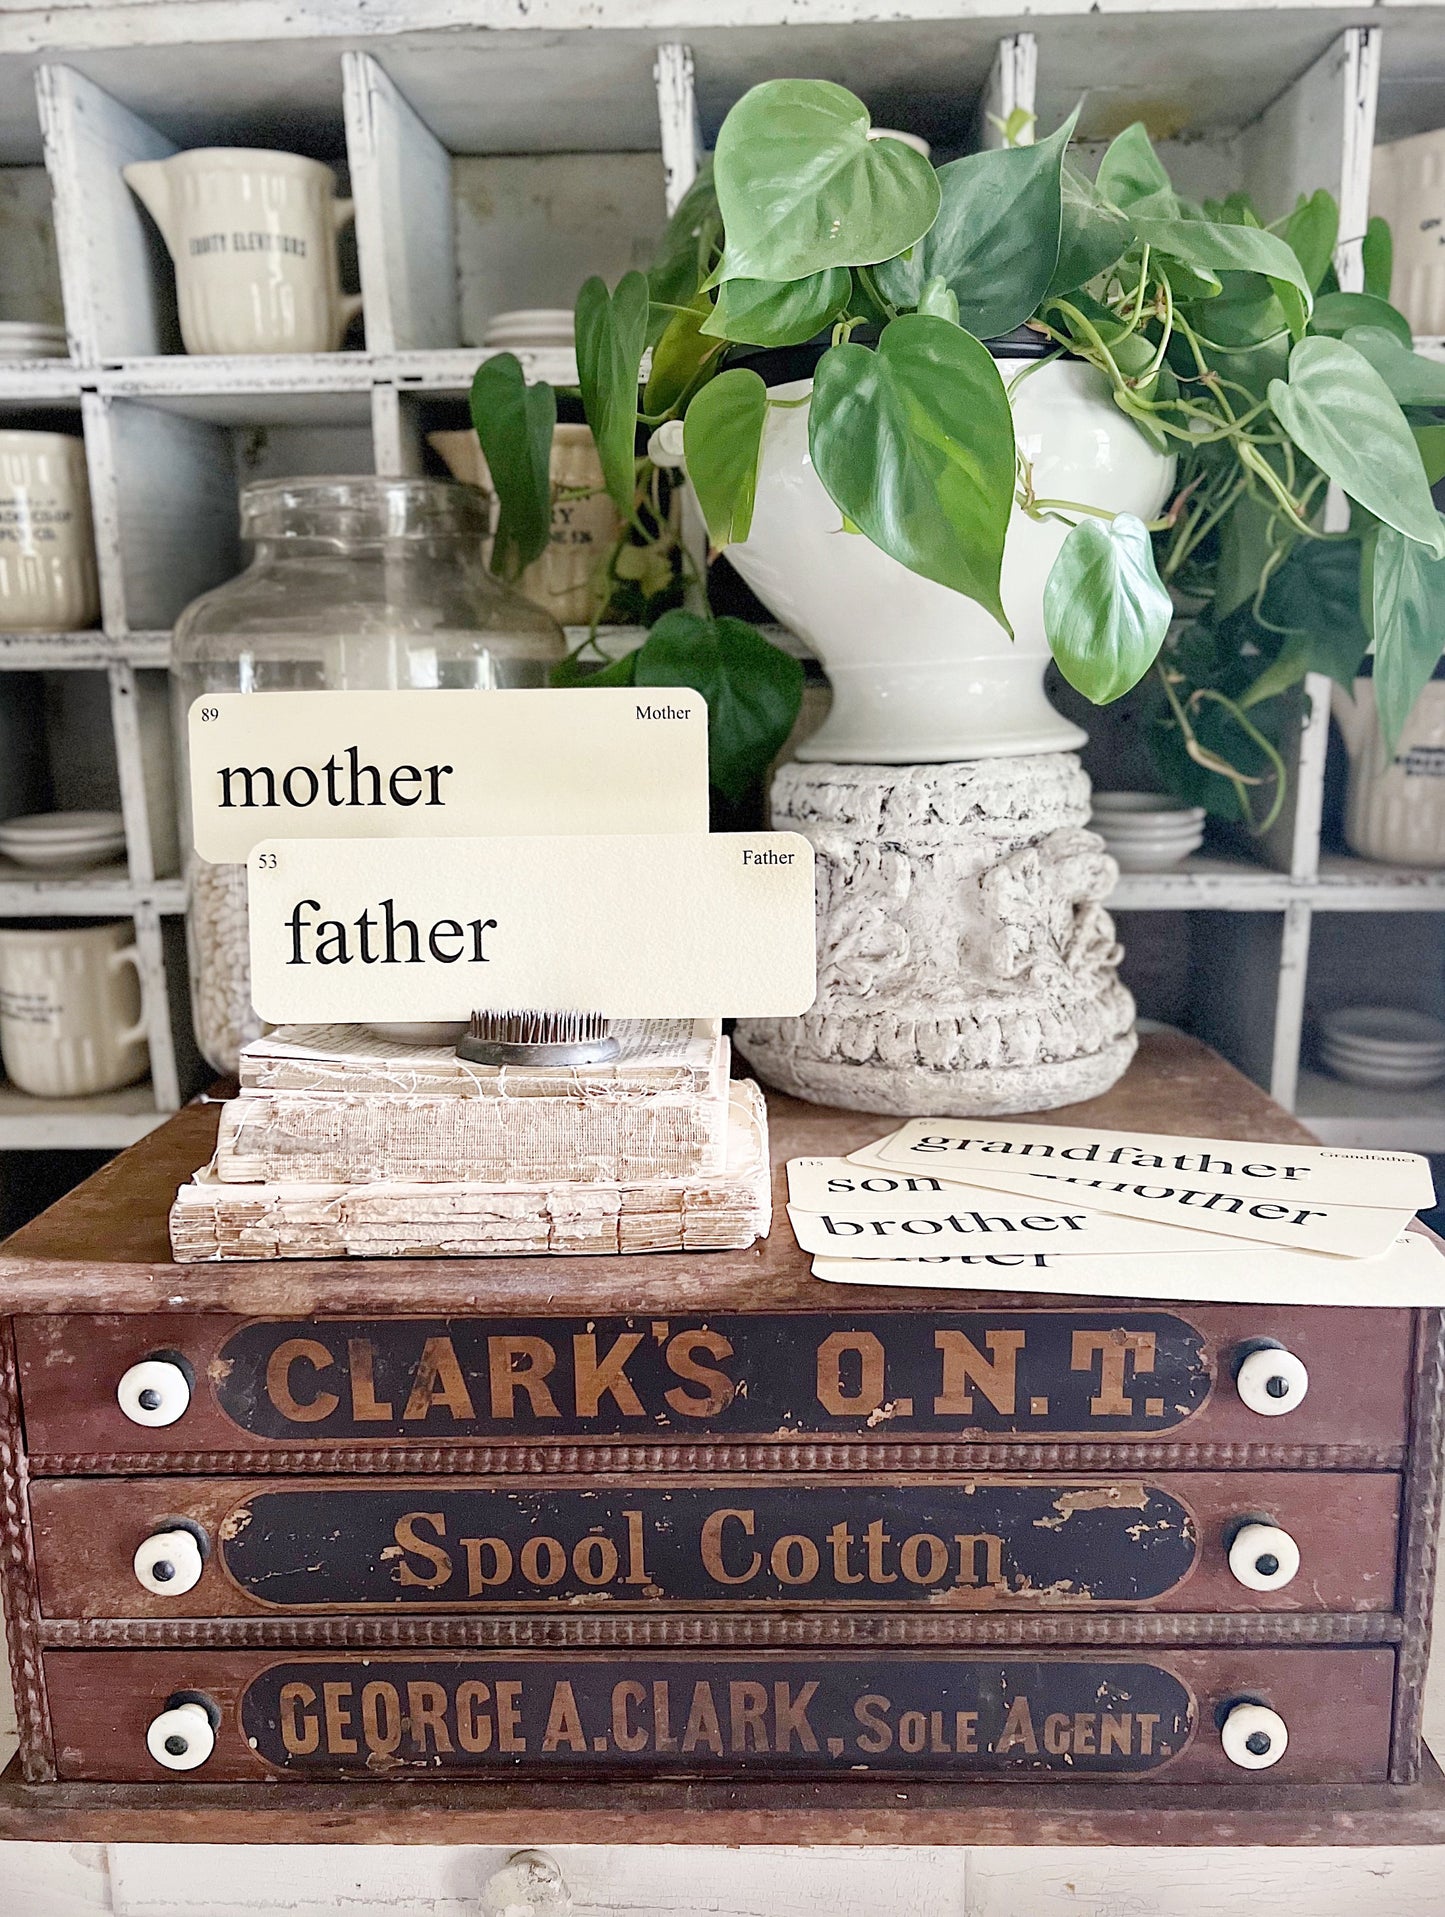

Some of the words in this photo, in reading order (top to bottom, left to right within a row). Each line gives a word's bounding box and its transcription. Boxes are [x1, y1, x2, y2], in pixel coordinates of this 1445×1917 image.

[201, 707, 219, 722] 89
[635, 705, 691, 720] Mother
[216, 745, 454, 808] mother
[258, 854, 278, 869] 53
[742, 849, 796, 865] Father
[284, 898, 498, 965] father
[910, 1136, 1311, 1181] grandfather
[827, 1177, 948, 1193] son
[819, 1212, 1087, 1236] brother
[266, 1320, 735, 1421] CLARK'S
[393, 1510, 653, 1598] Spool
[701, 1508, 1005, 1585] Cotton
[279, 1680, 527, 1755] GEORGE
